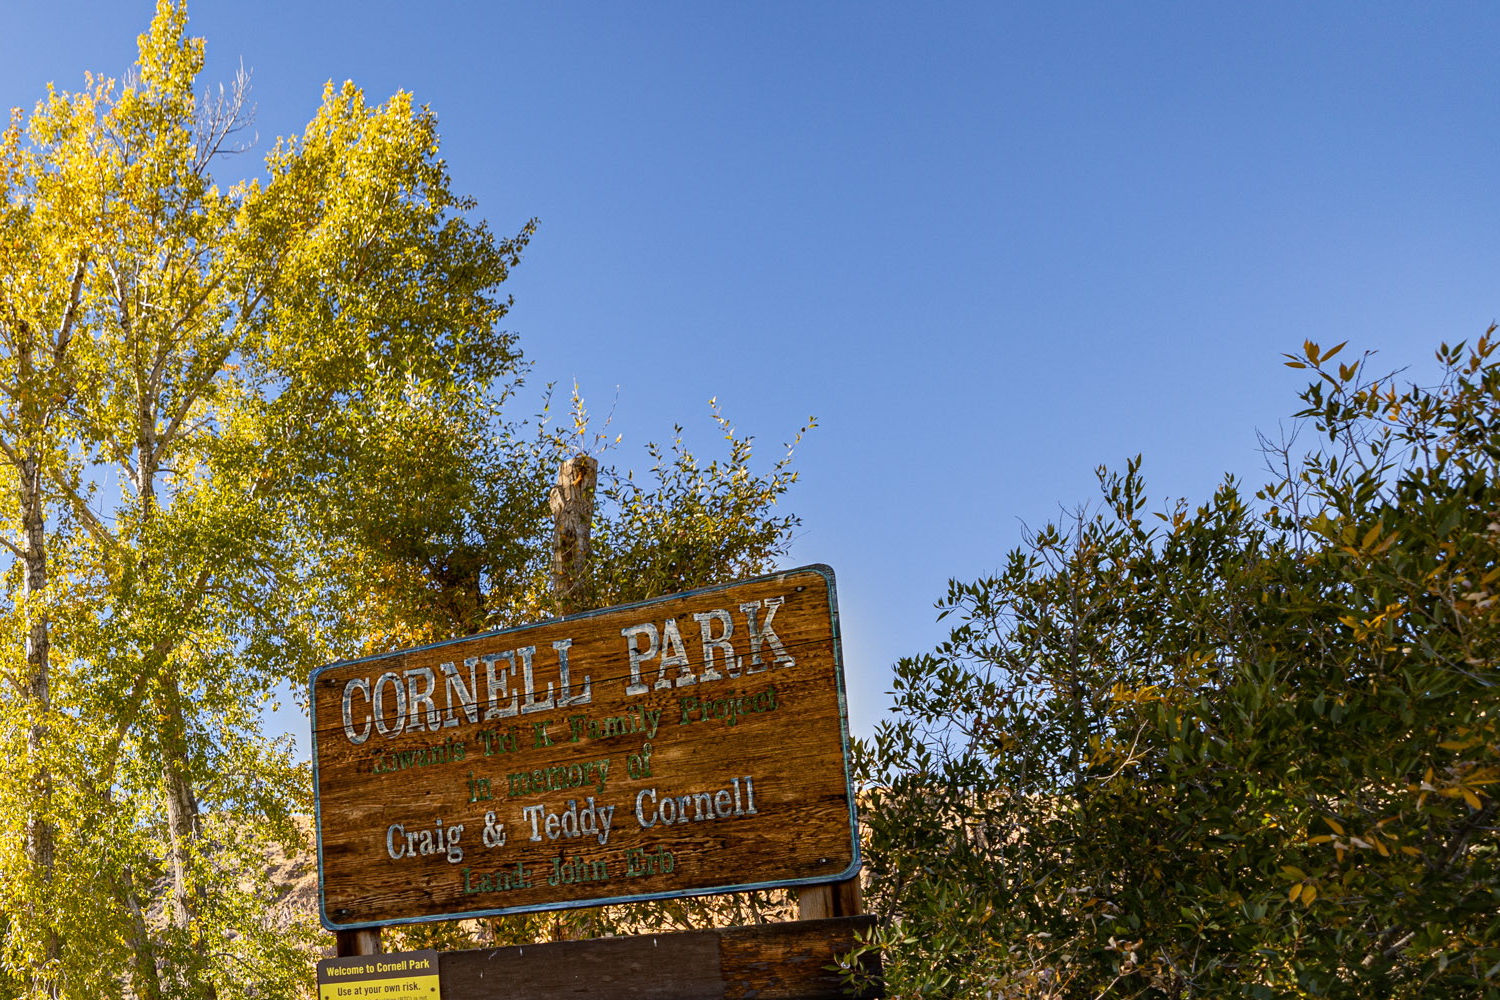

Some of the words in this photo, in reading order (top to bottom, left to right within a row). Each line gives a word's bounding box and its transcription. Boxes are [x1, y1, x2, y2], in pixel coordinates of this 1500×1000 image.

[342, 639, 591, 744] CORNELL
[621, 596, 795, 695] PARK
[479, 726, 517, 757] Tri
[533, 720, 556, 749] K
[568, 704, 661, 743] Family
[679, 685, 779, 726] Project
[468, 771, 492, 803] in
[507, 759, 610, 795] memory
[627, 742, 653, 779] of
[387, 819, 463, 863] Craig
[483, 811, 507, 847] &
[523, 797, 614, 844] Teddy
[635, 776, 758, 828] Cornell
[463, 862, 532, 894] Land:
[548, 854, 610, 886] John
[626, 846, 675, 877] Erb
[326, 966, 364, 976] Welcome
[366, 964, 375, 974] to
[376, 960, 407, 972] Cornell
[409, 958, 430, 969] Park
[337, 987, 352, 996] Use
[354, 986, 363, 995] at
[364, 985, 382, 996] your
[384, 984, 400, 993] own
[402, 982, 421, 991] risk.
